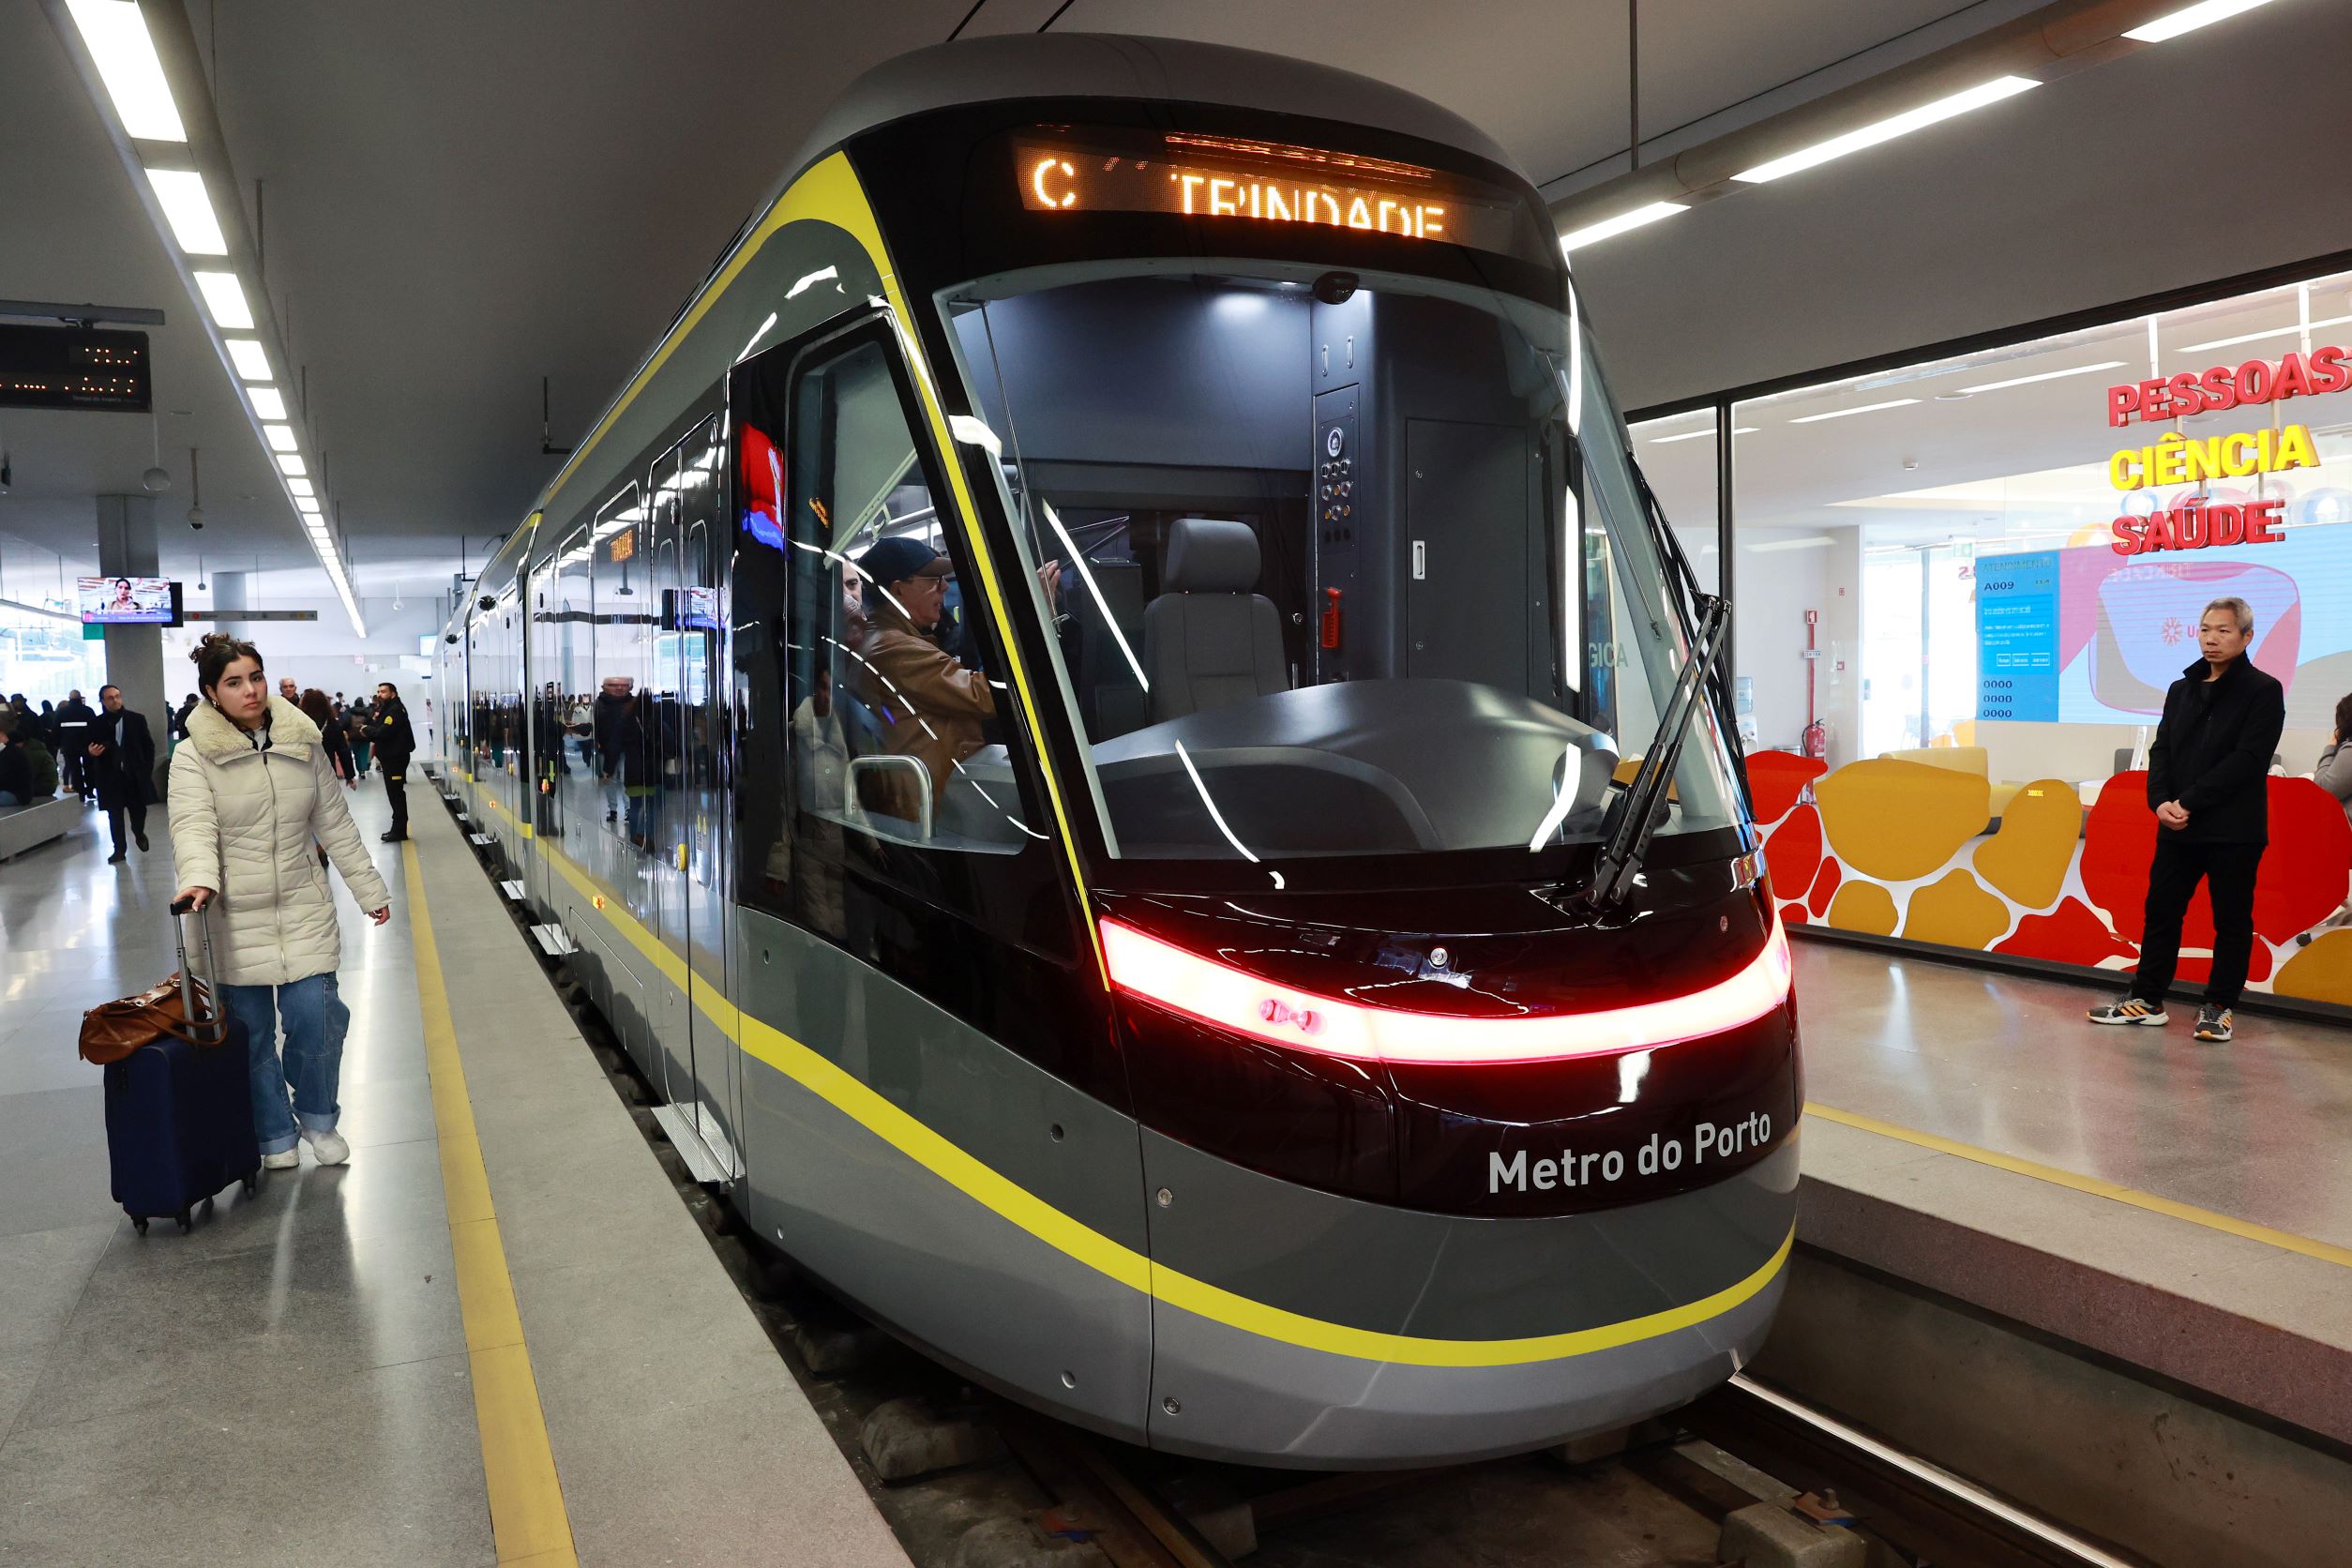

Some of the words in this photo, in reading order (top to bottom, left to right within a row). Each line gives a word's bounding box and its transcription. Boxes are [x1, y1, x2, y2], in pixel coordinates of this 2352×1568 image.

[1034, 159, 1075, 207] C
[2107, 345, 2352, 427] PESSOAS
[2109, 425, 2321, 490] CIÊNCIA
[2111, 497, 2286, 555] SAÚDE
[1983, 580, 2014, 591] A009
[1489, 1149, 1624, 1194] Metro
[1638, 1133, 1682, 1175] do
[1696, 1111, 1772, 1164] Porto
